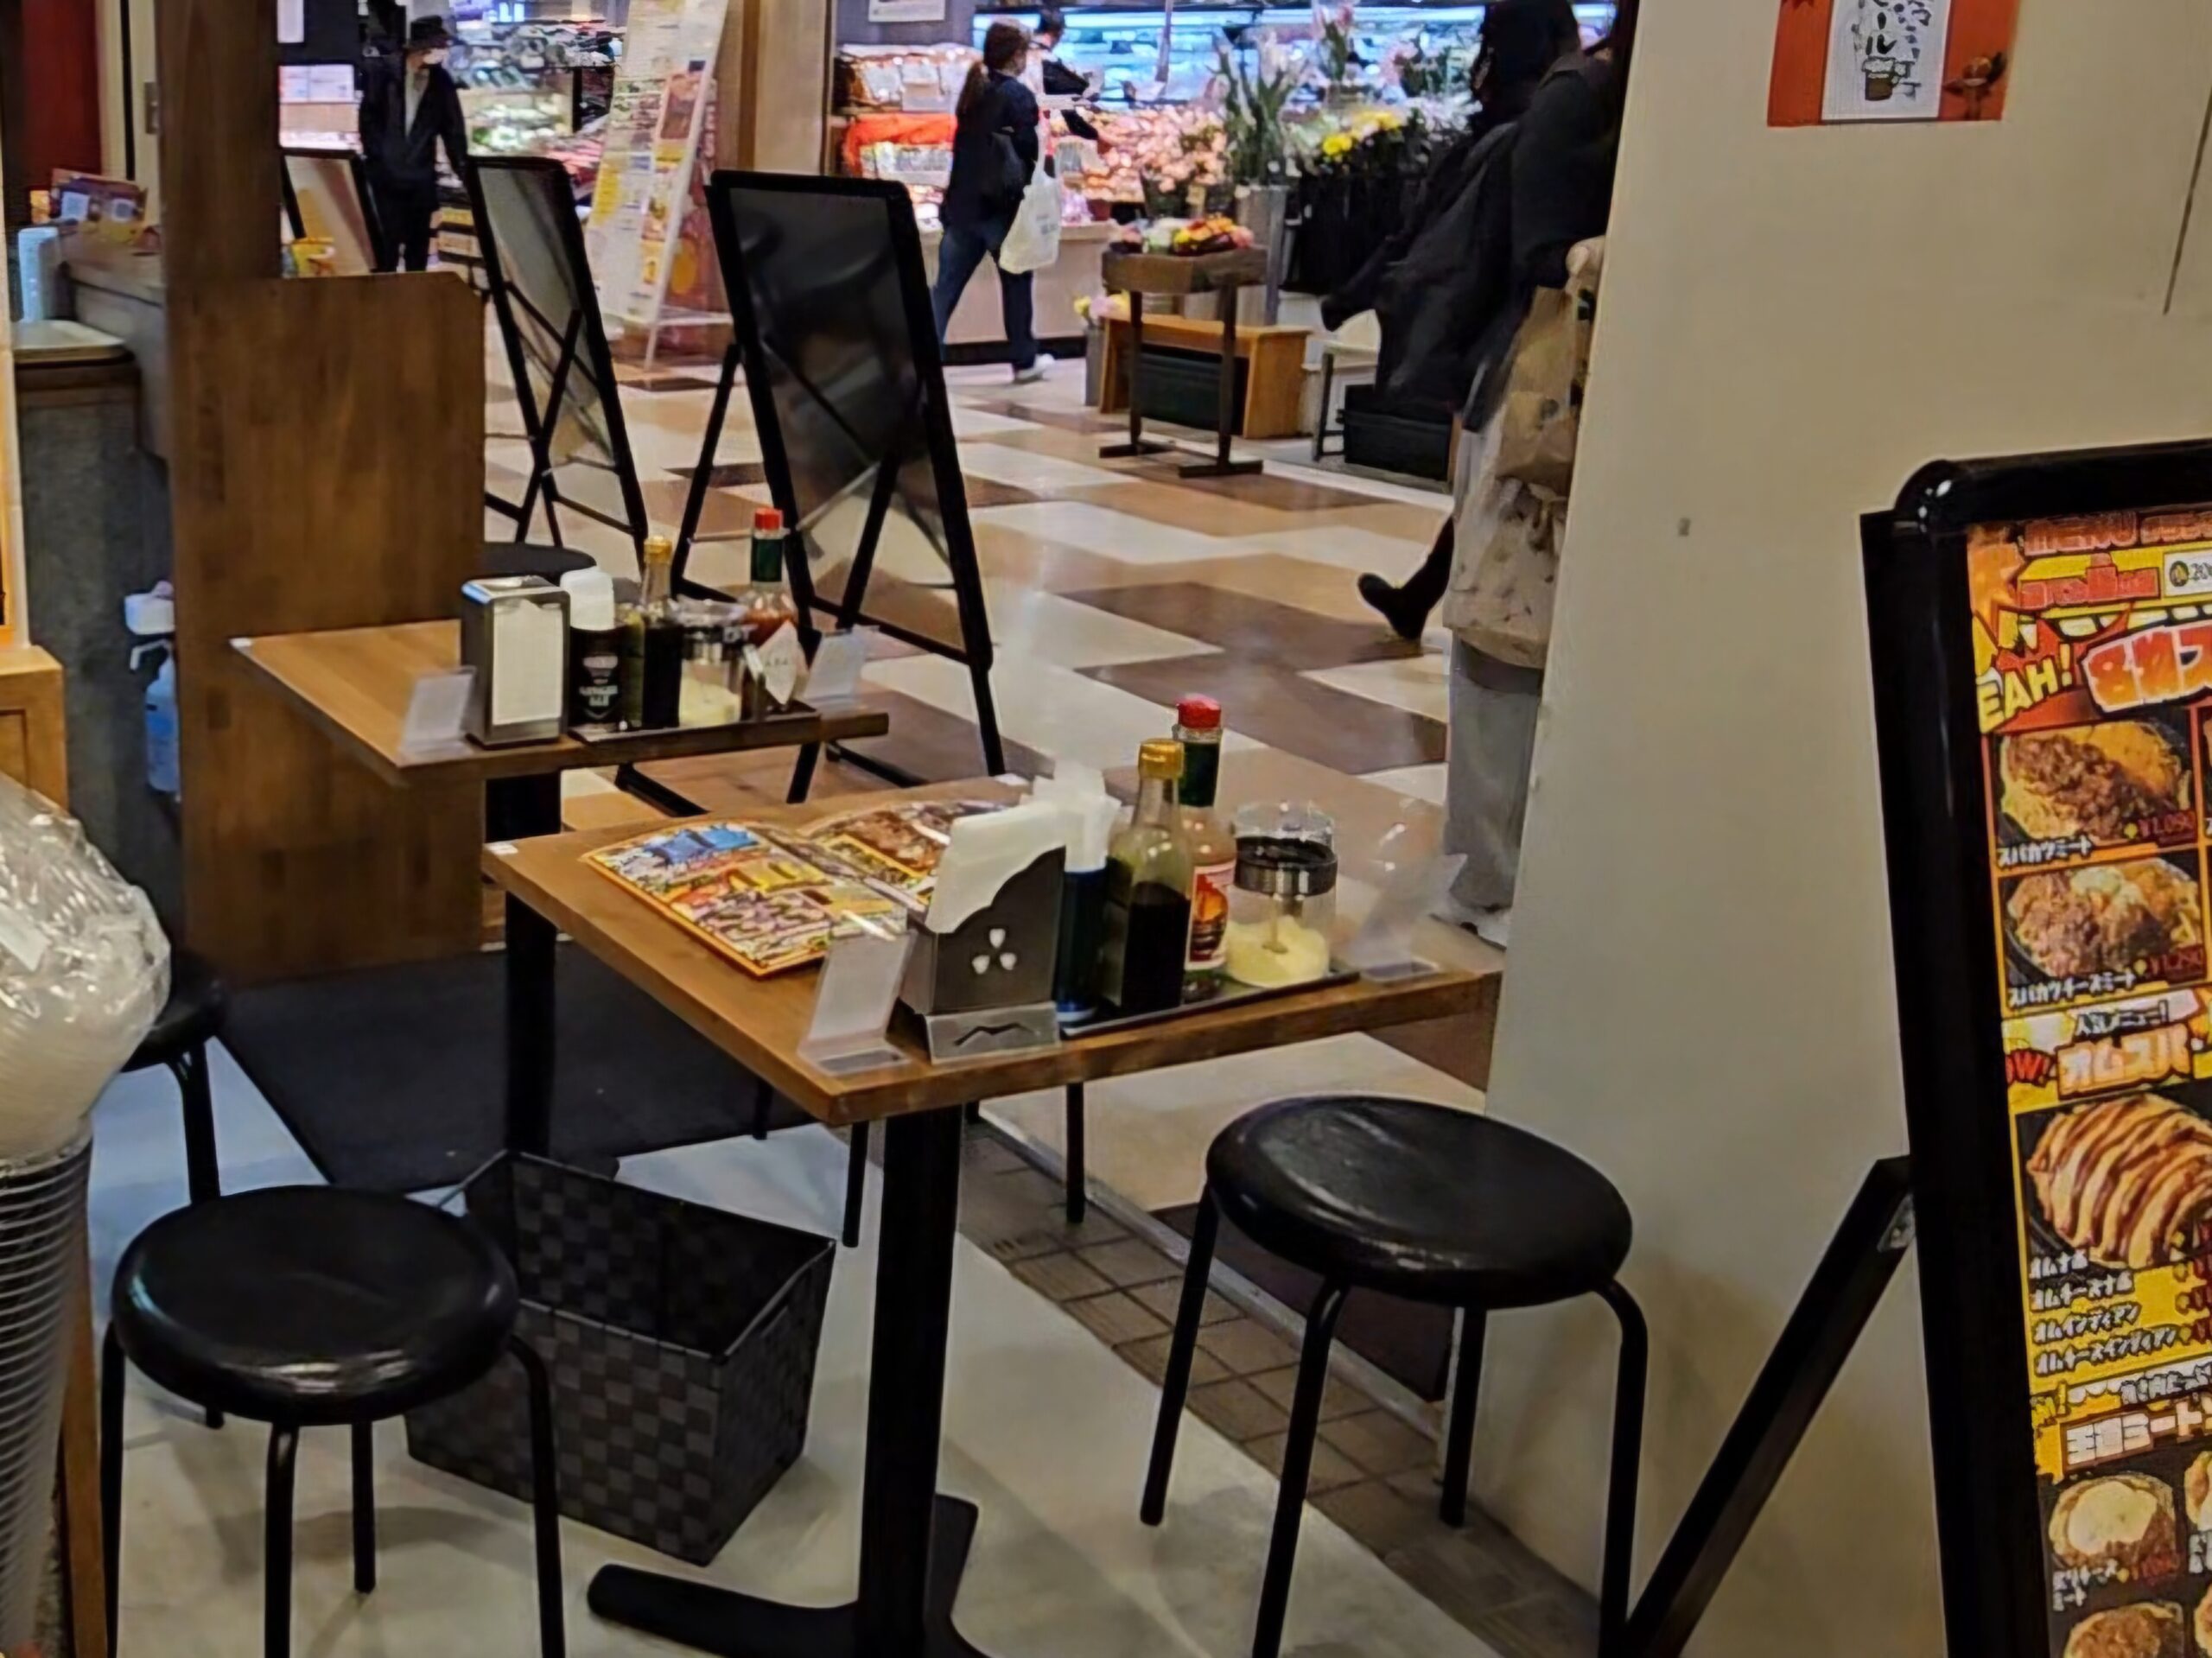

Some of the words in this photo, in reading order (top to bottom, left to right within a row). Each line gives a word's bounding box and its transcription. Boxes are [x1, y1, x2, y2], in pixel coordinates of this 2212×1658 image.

[1998, 834, 2093, 867] スパカツミート
[2007, 968, 2137, 1007] スパカツチーズミート
